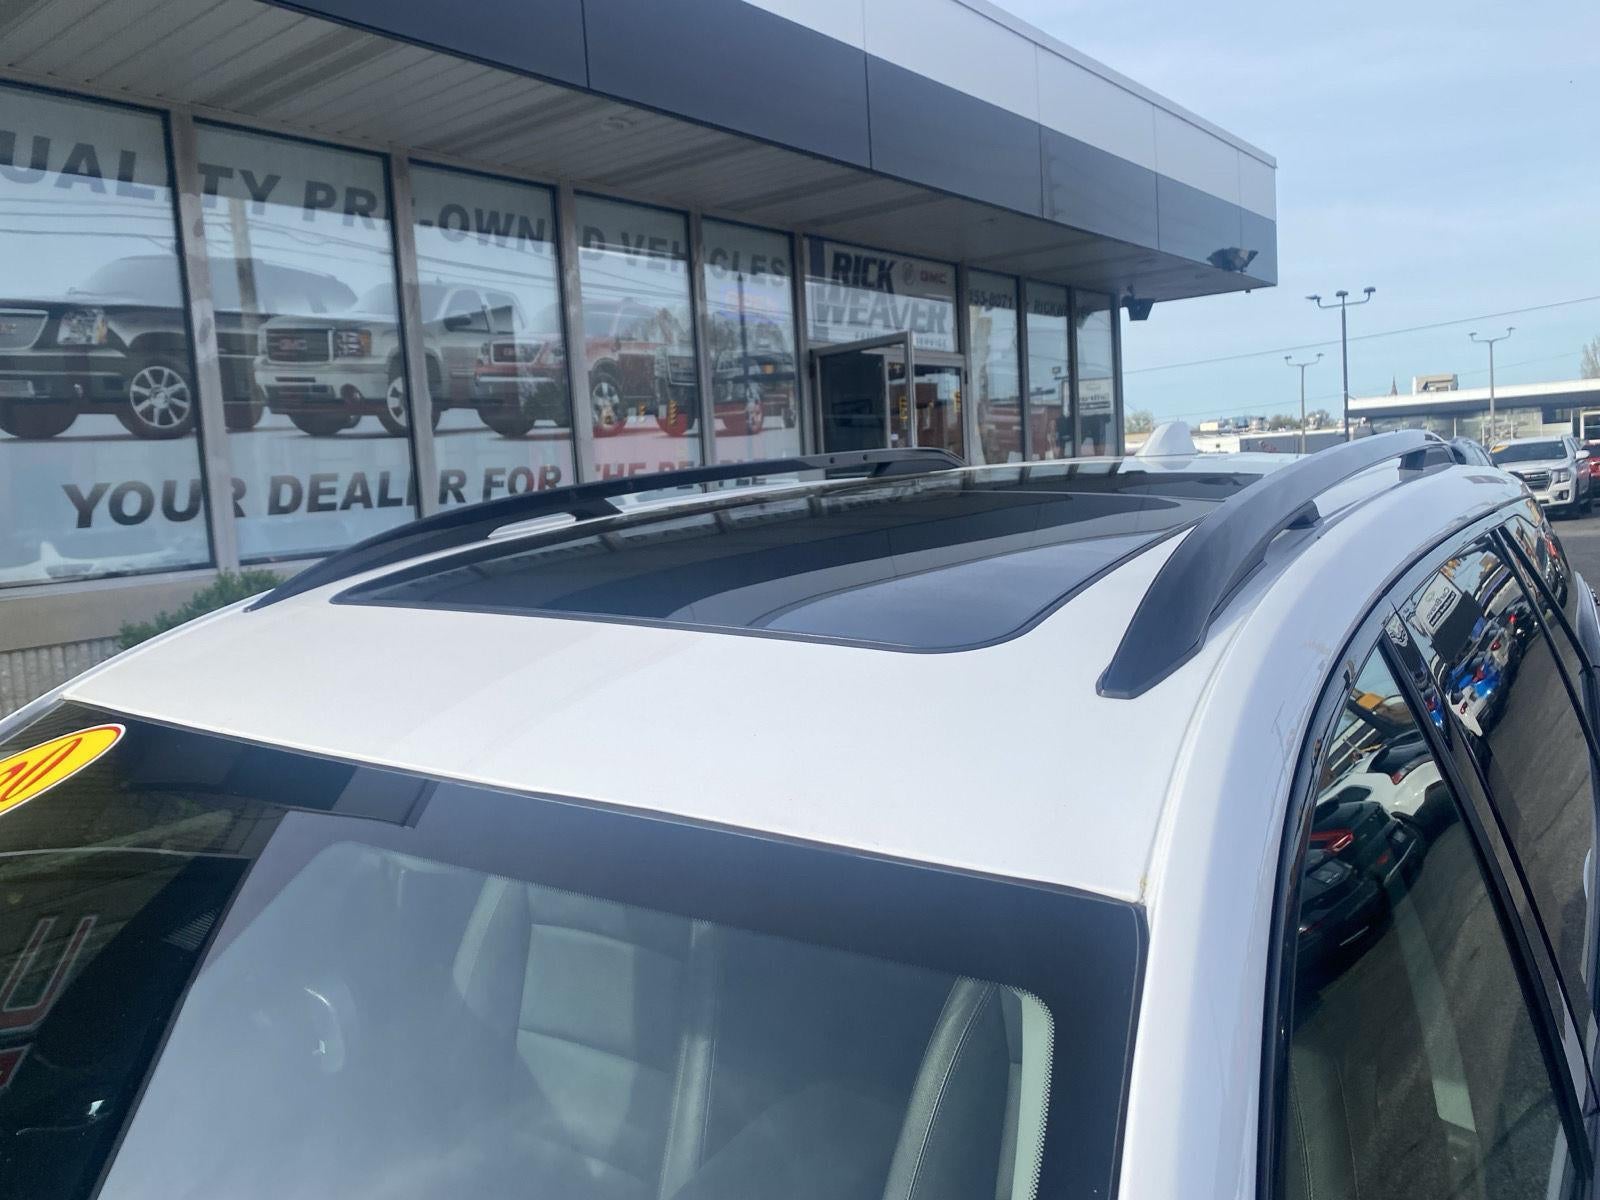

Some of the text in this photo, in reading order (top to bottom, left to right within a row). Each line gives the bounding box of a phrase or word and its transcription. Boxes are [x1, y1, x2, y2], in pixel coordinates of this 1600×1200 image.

[0, 130, 788, 287] UALTY PR-OWND VEHCLES
[831, 251, 898, 295] RICK
[814, 285, 948, 334] WEAVER
[481, 464, 562, 503] FOR
